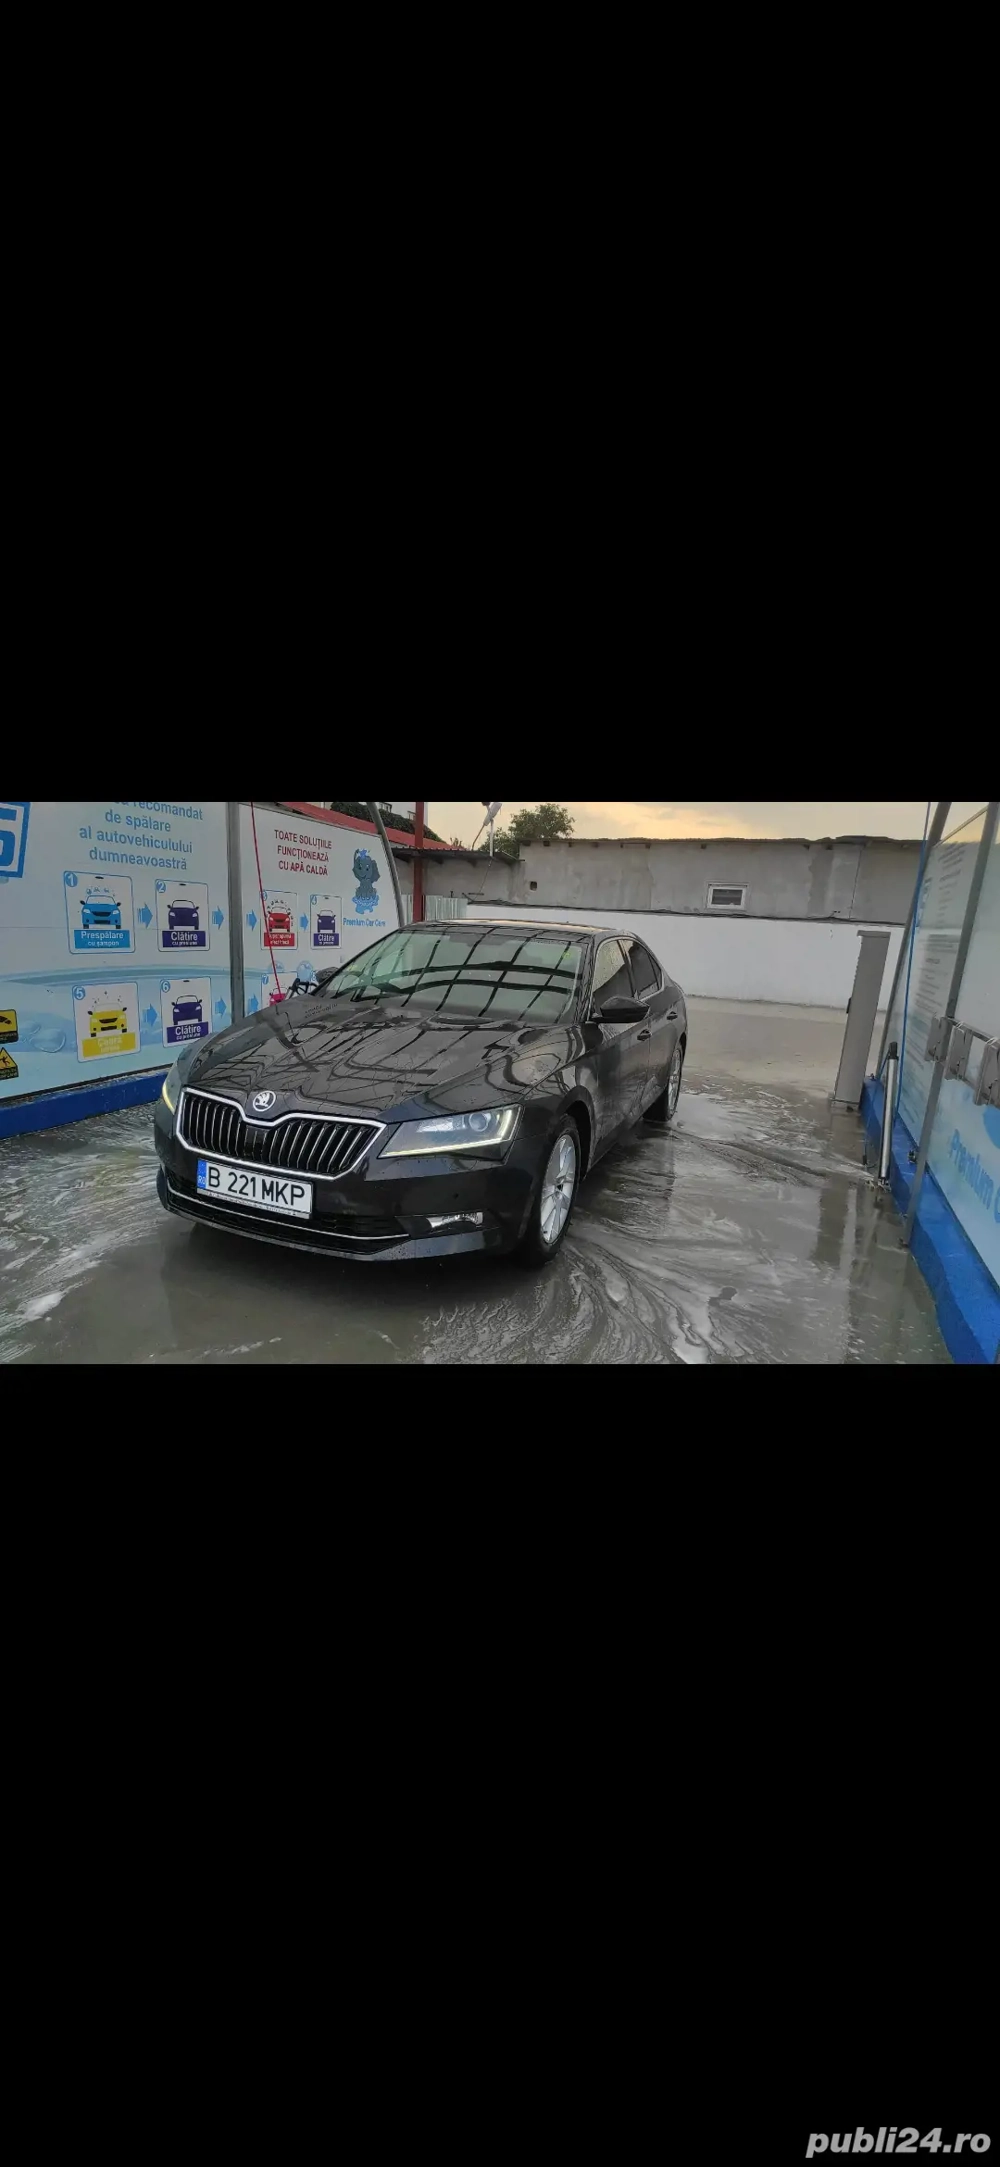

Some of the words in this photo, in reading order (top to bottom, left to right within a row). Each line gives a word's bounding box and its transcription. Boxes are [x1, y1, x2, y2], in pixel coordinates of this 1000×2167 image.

[134, 802, 203, 820] recomandat
[105, 809, 121, 823] de
[125, 815, 171, 832] spălare
[79, 826, 92, 840] al
[96, 829, 193, 853] autovehiculului
[274, 829, 298, 843] TOATE
[89, 846, 187, 870] dumneavoastră
[278, 860, 289, 871] CU
[290, 860, 305, 873] APĂ
[306, 864, 328, 876] CALDĂ
[80, 931, 124, 941] Prespălare
[171, 931, 198, 942] Clătire
[175, 1024, 202, 1036] Clătire
[208, 1166, 220, 1188] B
[227, 1171, 256, 1198] 221
[261, 1178, 305, 1206] MKP
